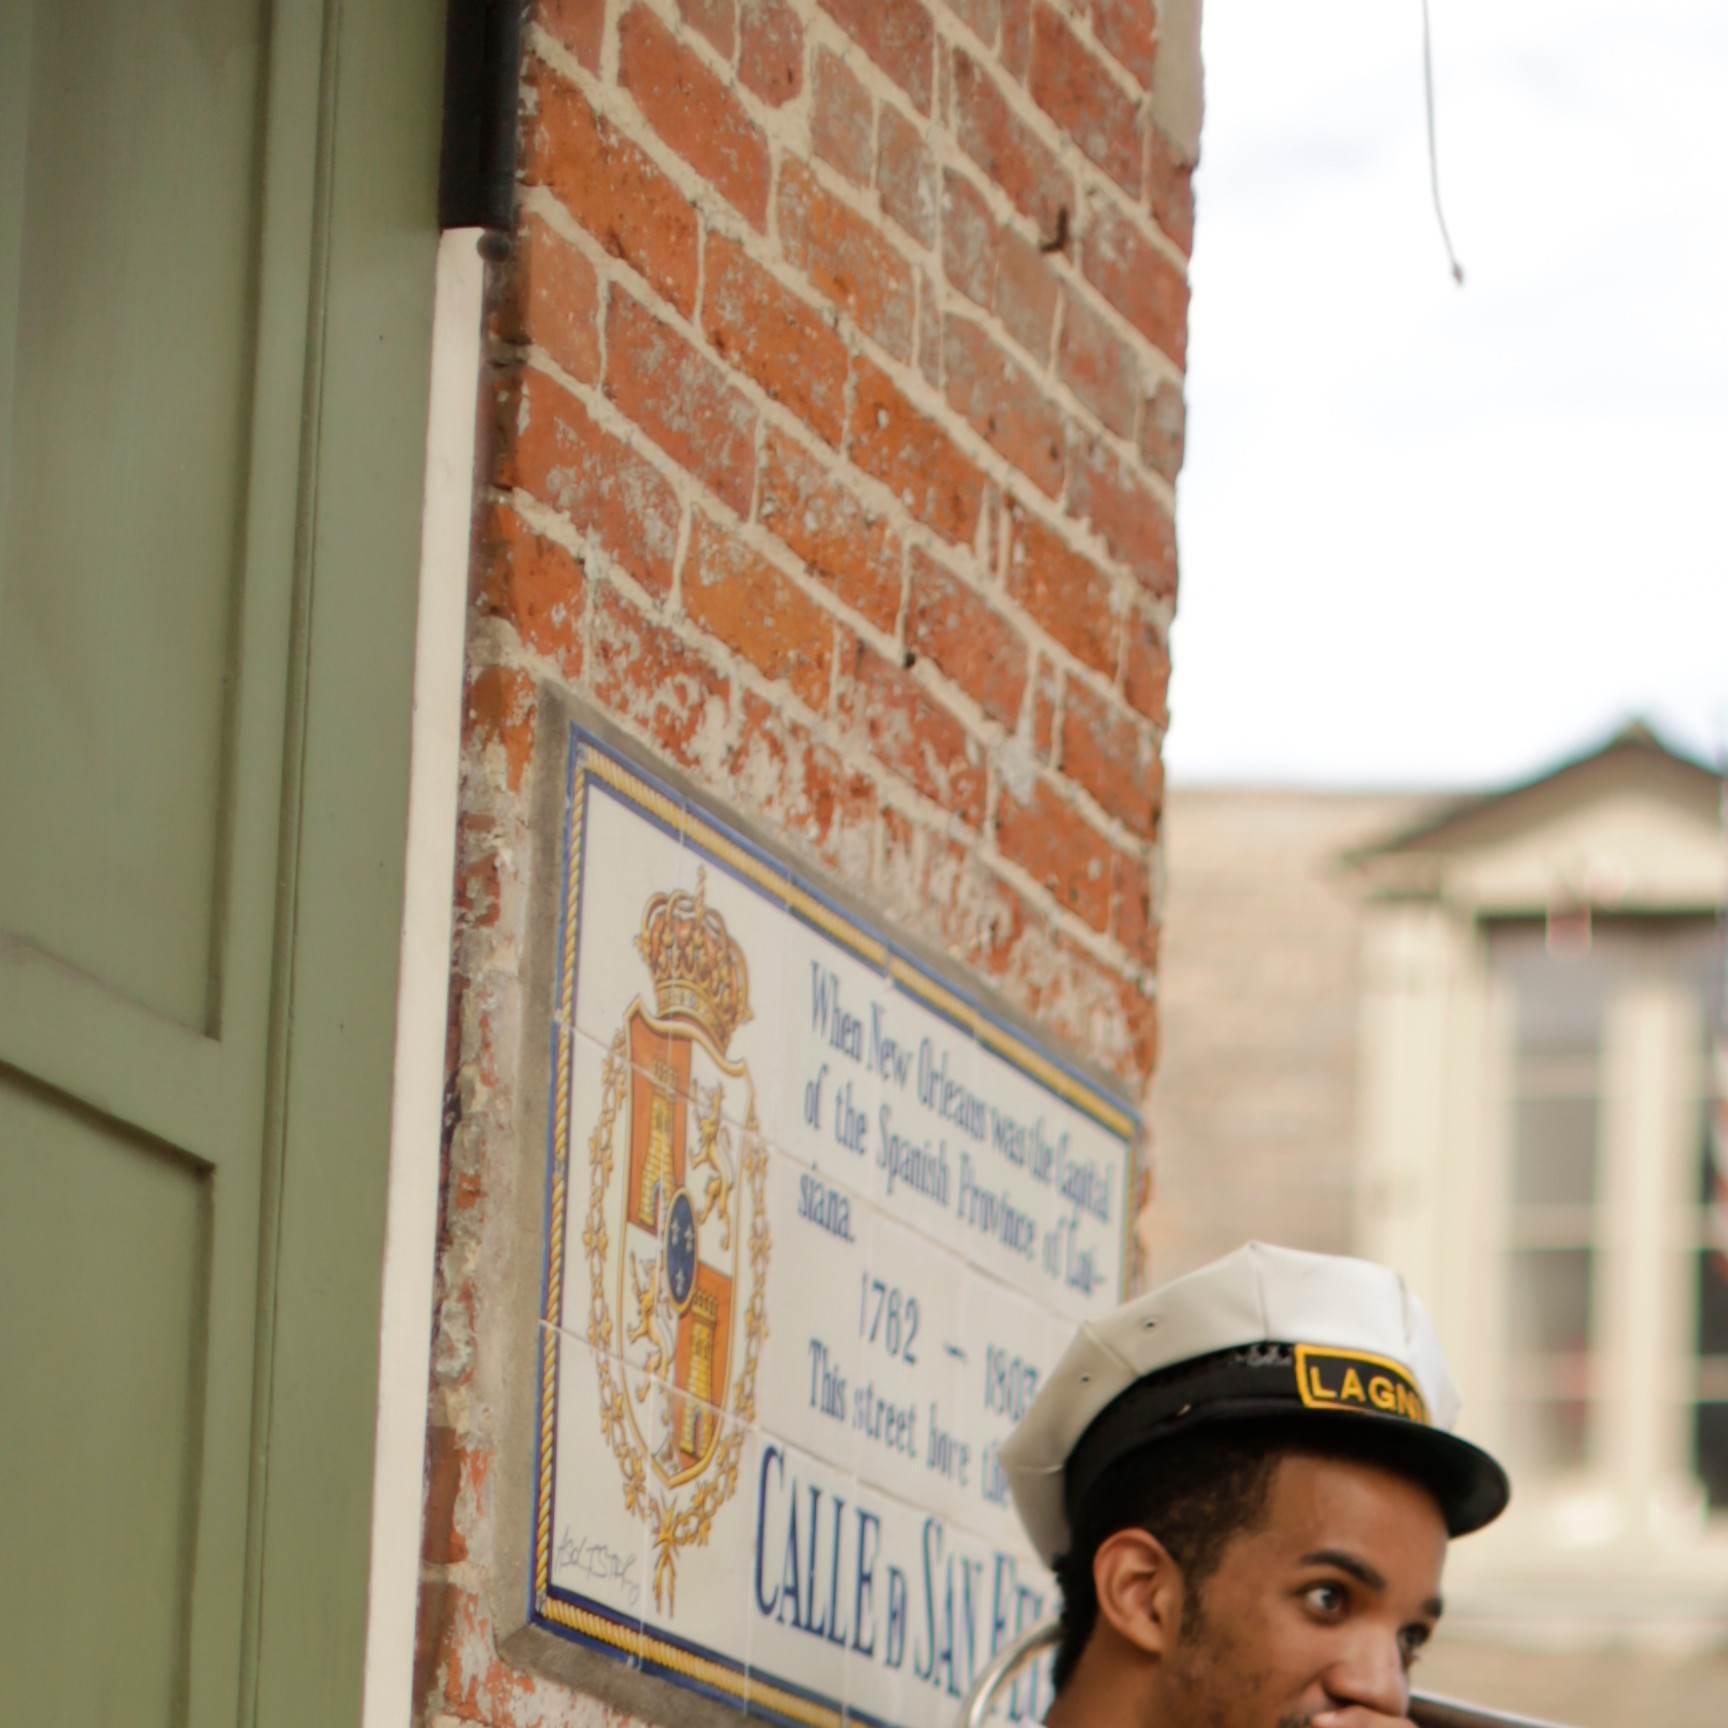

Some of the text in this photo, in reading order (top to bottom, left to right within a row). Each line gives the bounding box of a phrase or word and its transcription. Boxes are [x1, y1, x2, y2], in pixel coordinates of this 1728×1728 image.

[810, 960, 862, 1062] When
[867, 1001, 913, 1090] New
[918, 1035, 986, 1142] Orleans
[991, 1106, 1026, 1166] was
[1028, 1116, 1053, 1185] the
[798, 1162, 855, 1243] siana.
[804, 1063, 828, 1130] of
[835, 1080, 866, 1155] the
[876, 1103, 948, 1206] Spanish
[957, 1150, 1036, 1260] Province
[858, 1270, 918, 1366] 1762
[808, 1336, 846, 1422] This
[853, 1380, 916, 1458] street
[926, 1400, 968, 1488] bore
[754, 1446, 881, 1660] CALLE
[914, 1516, 982, 1698] SAN
